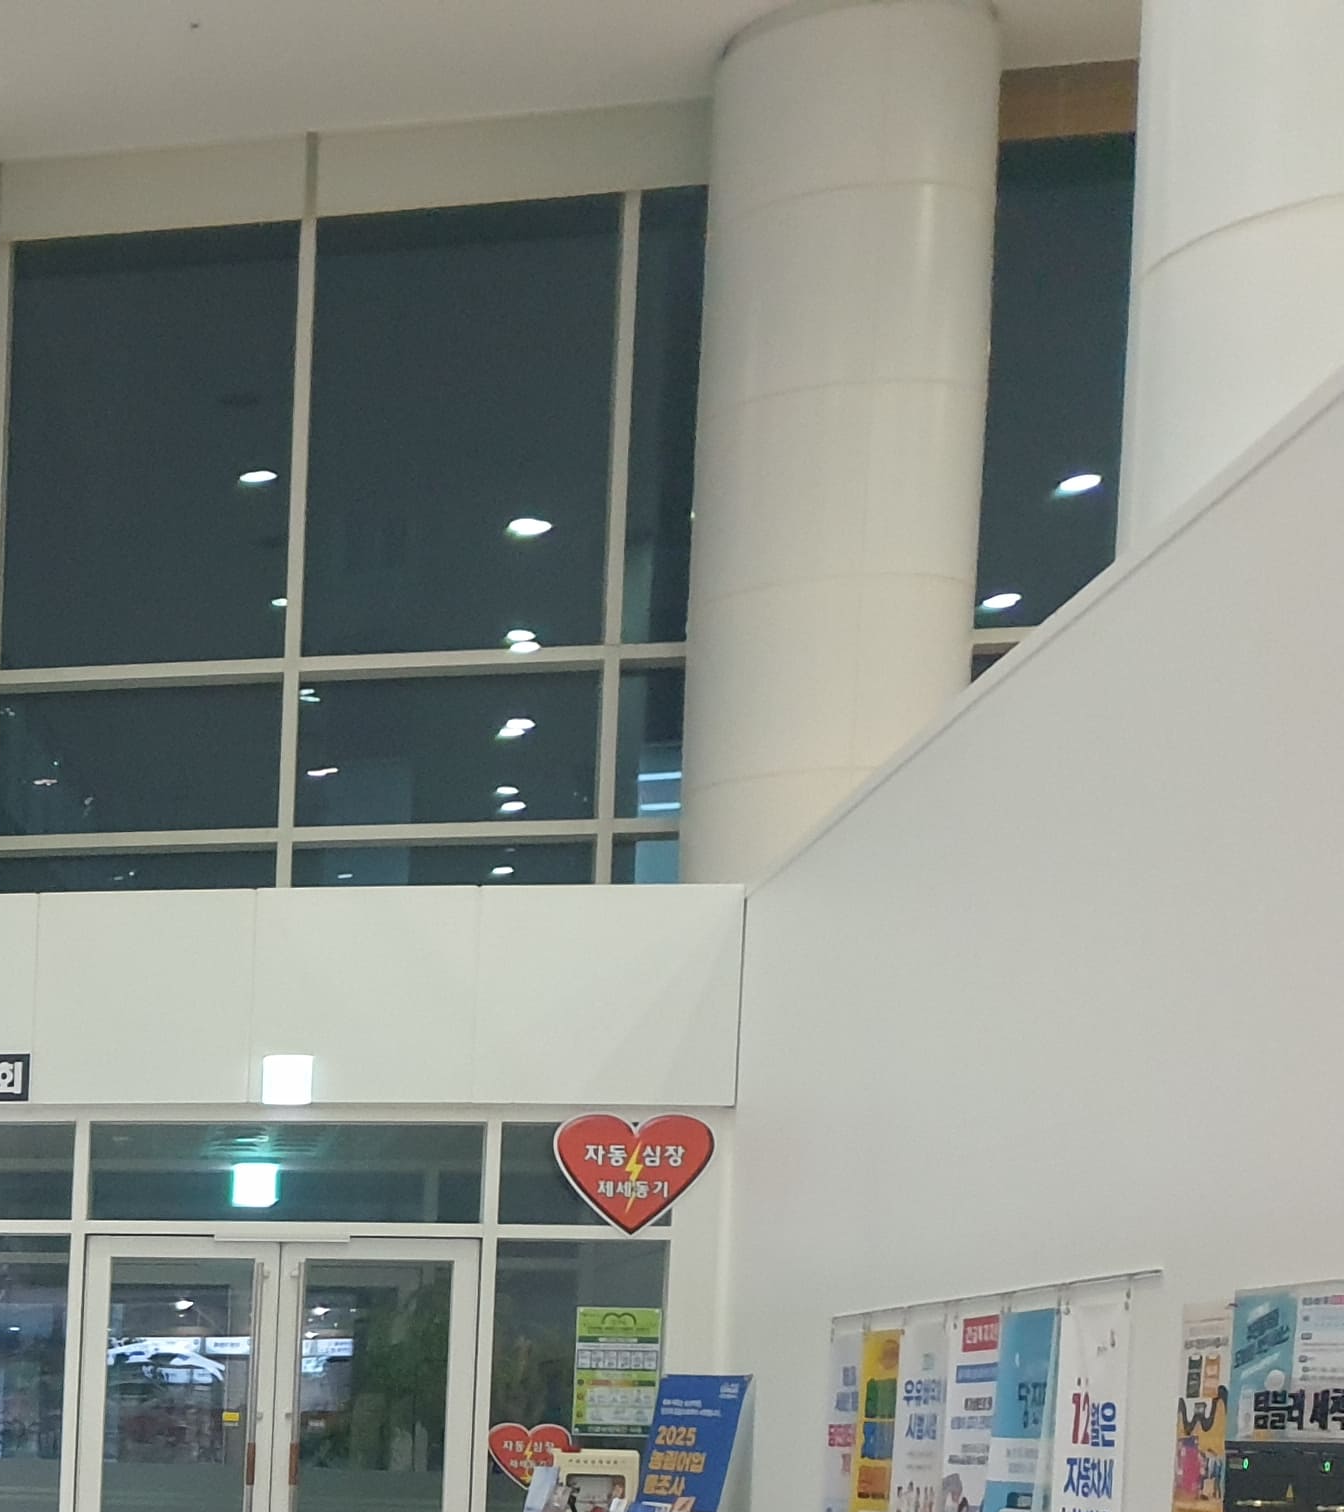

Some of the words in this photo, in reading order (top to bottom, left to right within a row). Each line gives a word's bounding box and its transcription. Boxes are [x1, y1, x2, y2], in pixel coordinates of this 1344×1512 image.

[584, 1144, 628, 1167] 자동
[642, 1145, 686, 1167] 심장
[655, 1425, 697, 1446] 2025
